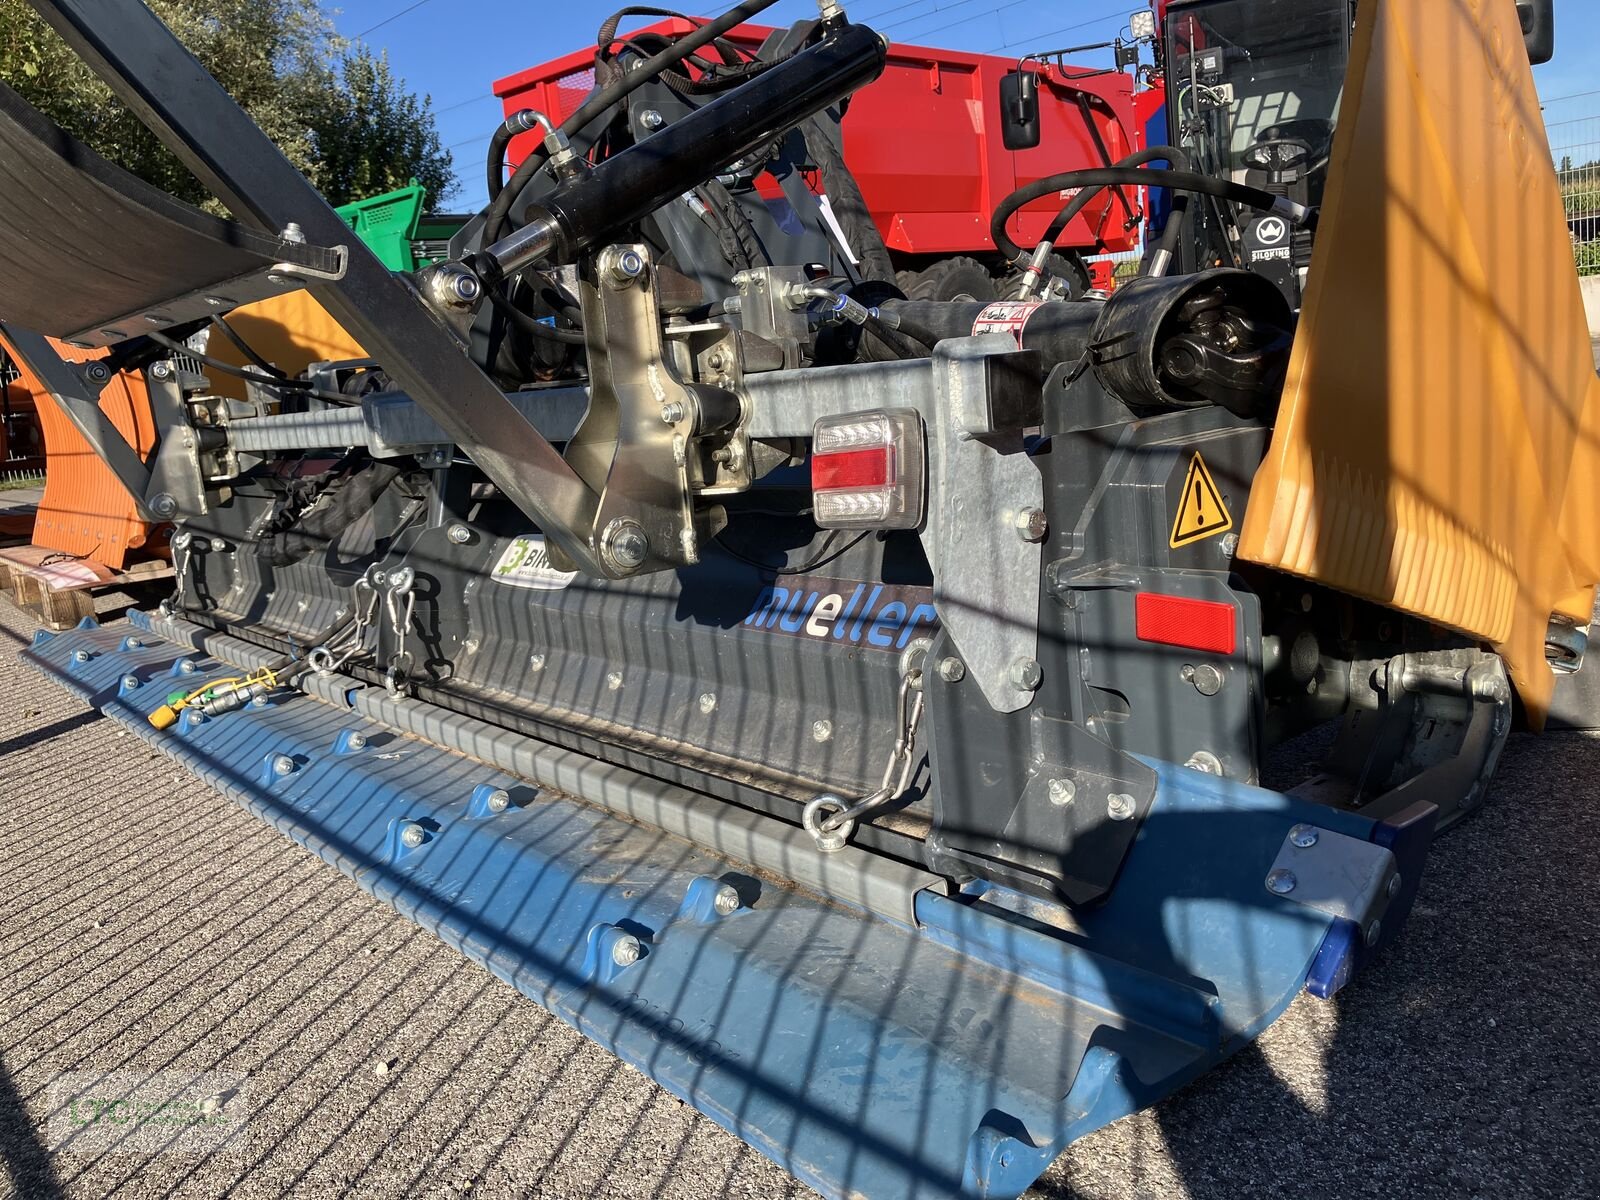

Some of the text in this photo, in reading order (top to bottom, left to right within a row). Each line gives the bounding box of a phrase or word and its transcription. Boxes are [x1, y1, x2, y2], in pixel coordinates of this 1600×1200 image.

[1251, 249, 1290, 261] SILOKING
[523, 549, 552, 570] BIN
[744, 583, 938, 649] mueller
